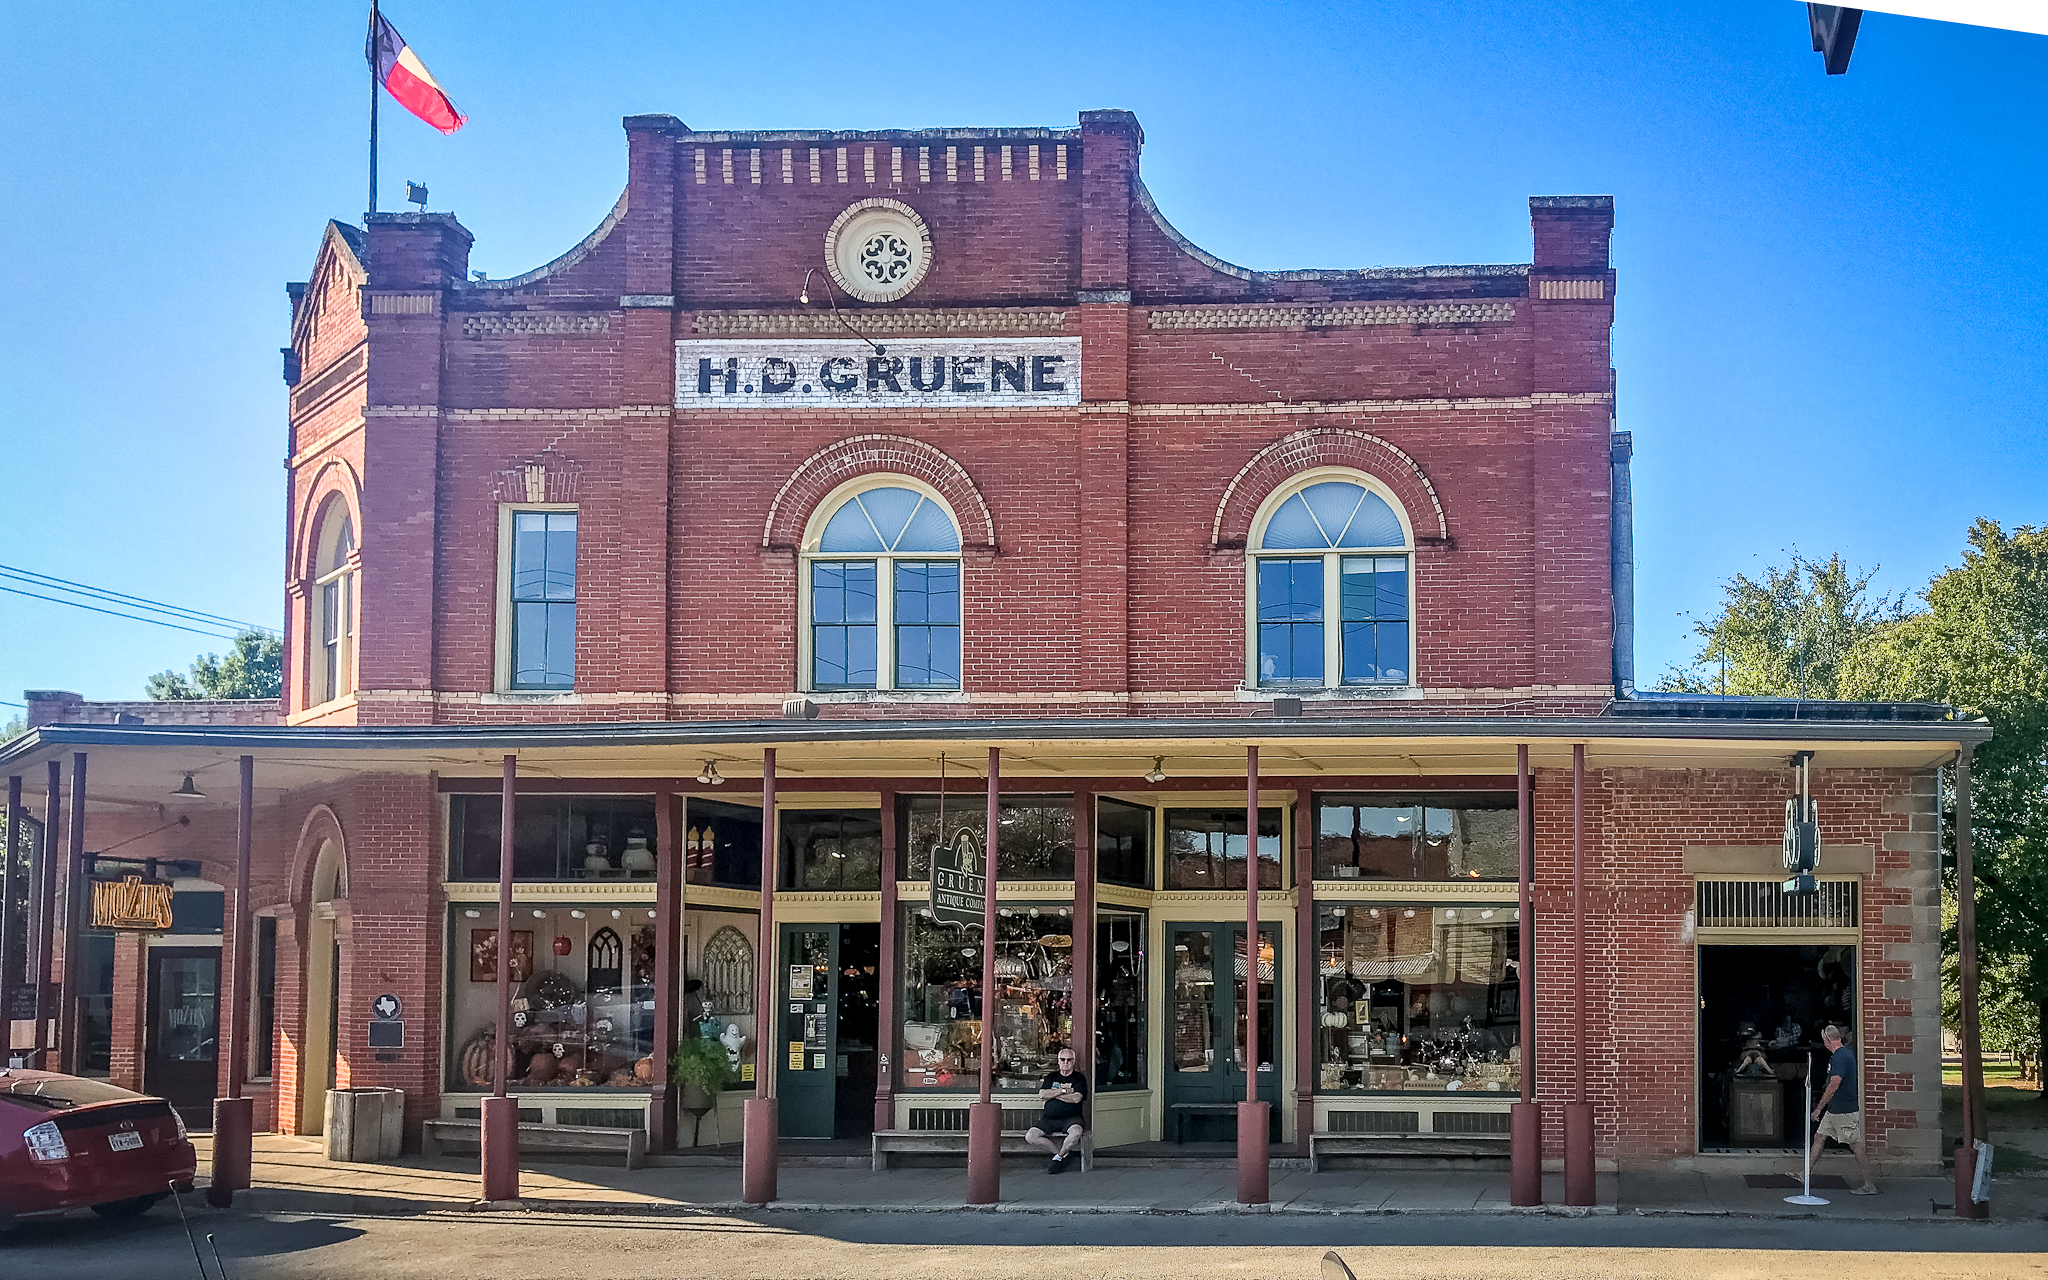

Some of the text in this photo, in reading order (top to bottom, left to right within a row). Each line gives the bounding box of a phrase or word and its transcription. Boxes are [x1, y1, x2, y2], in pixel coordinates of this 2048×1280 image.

[937, 871, 984, 893] GRUEN
[936, 893, 985, 910] ANTIQUE COMPA
